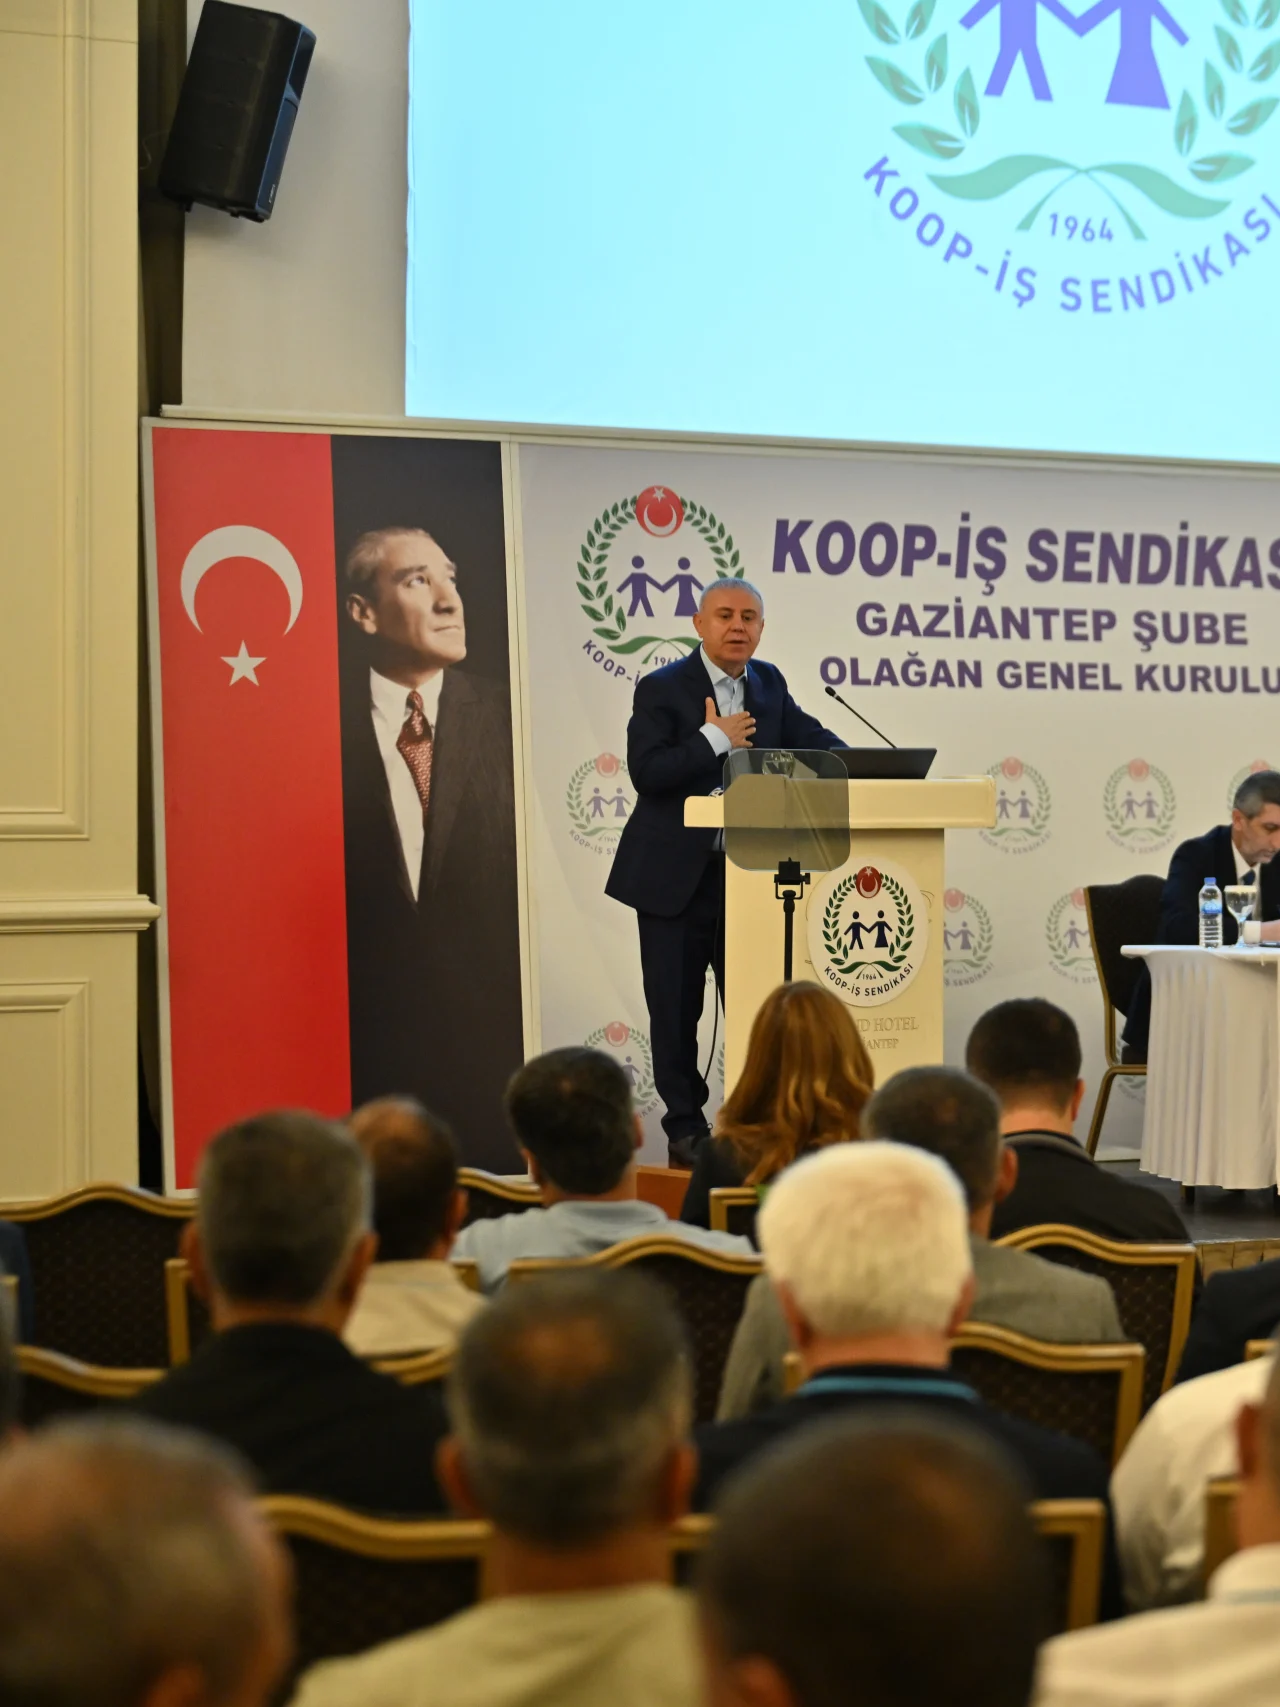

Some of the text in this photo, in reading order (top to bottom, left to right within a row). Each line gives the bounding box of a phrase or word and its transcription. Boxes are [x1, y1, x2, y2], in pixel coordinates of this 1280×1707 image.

[864, 156, 1037, 308] KOOP-İŞ
[1048, 212, 1113, 242] 1964
[772, 511, 1007, 596] KOOP-İŞ
[856, 597, 1248, 652] GAZİANTEP ŞUBE
[582, 639, 640, 687] KOOP-İ
[820, 650, 983, 688] OLAĞAN
[997, 659, 1122, 691] GENEL
[824, 963, 913, 996] KOOP-İŞ SENDİKASI
[873, 1016, 919, 1032] HOTEL
